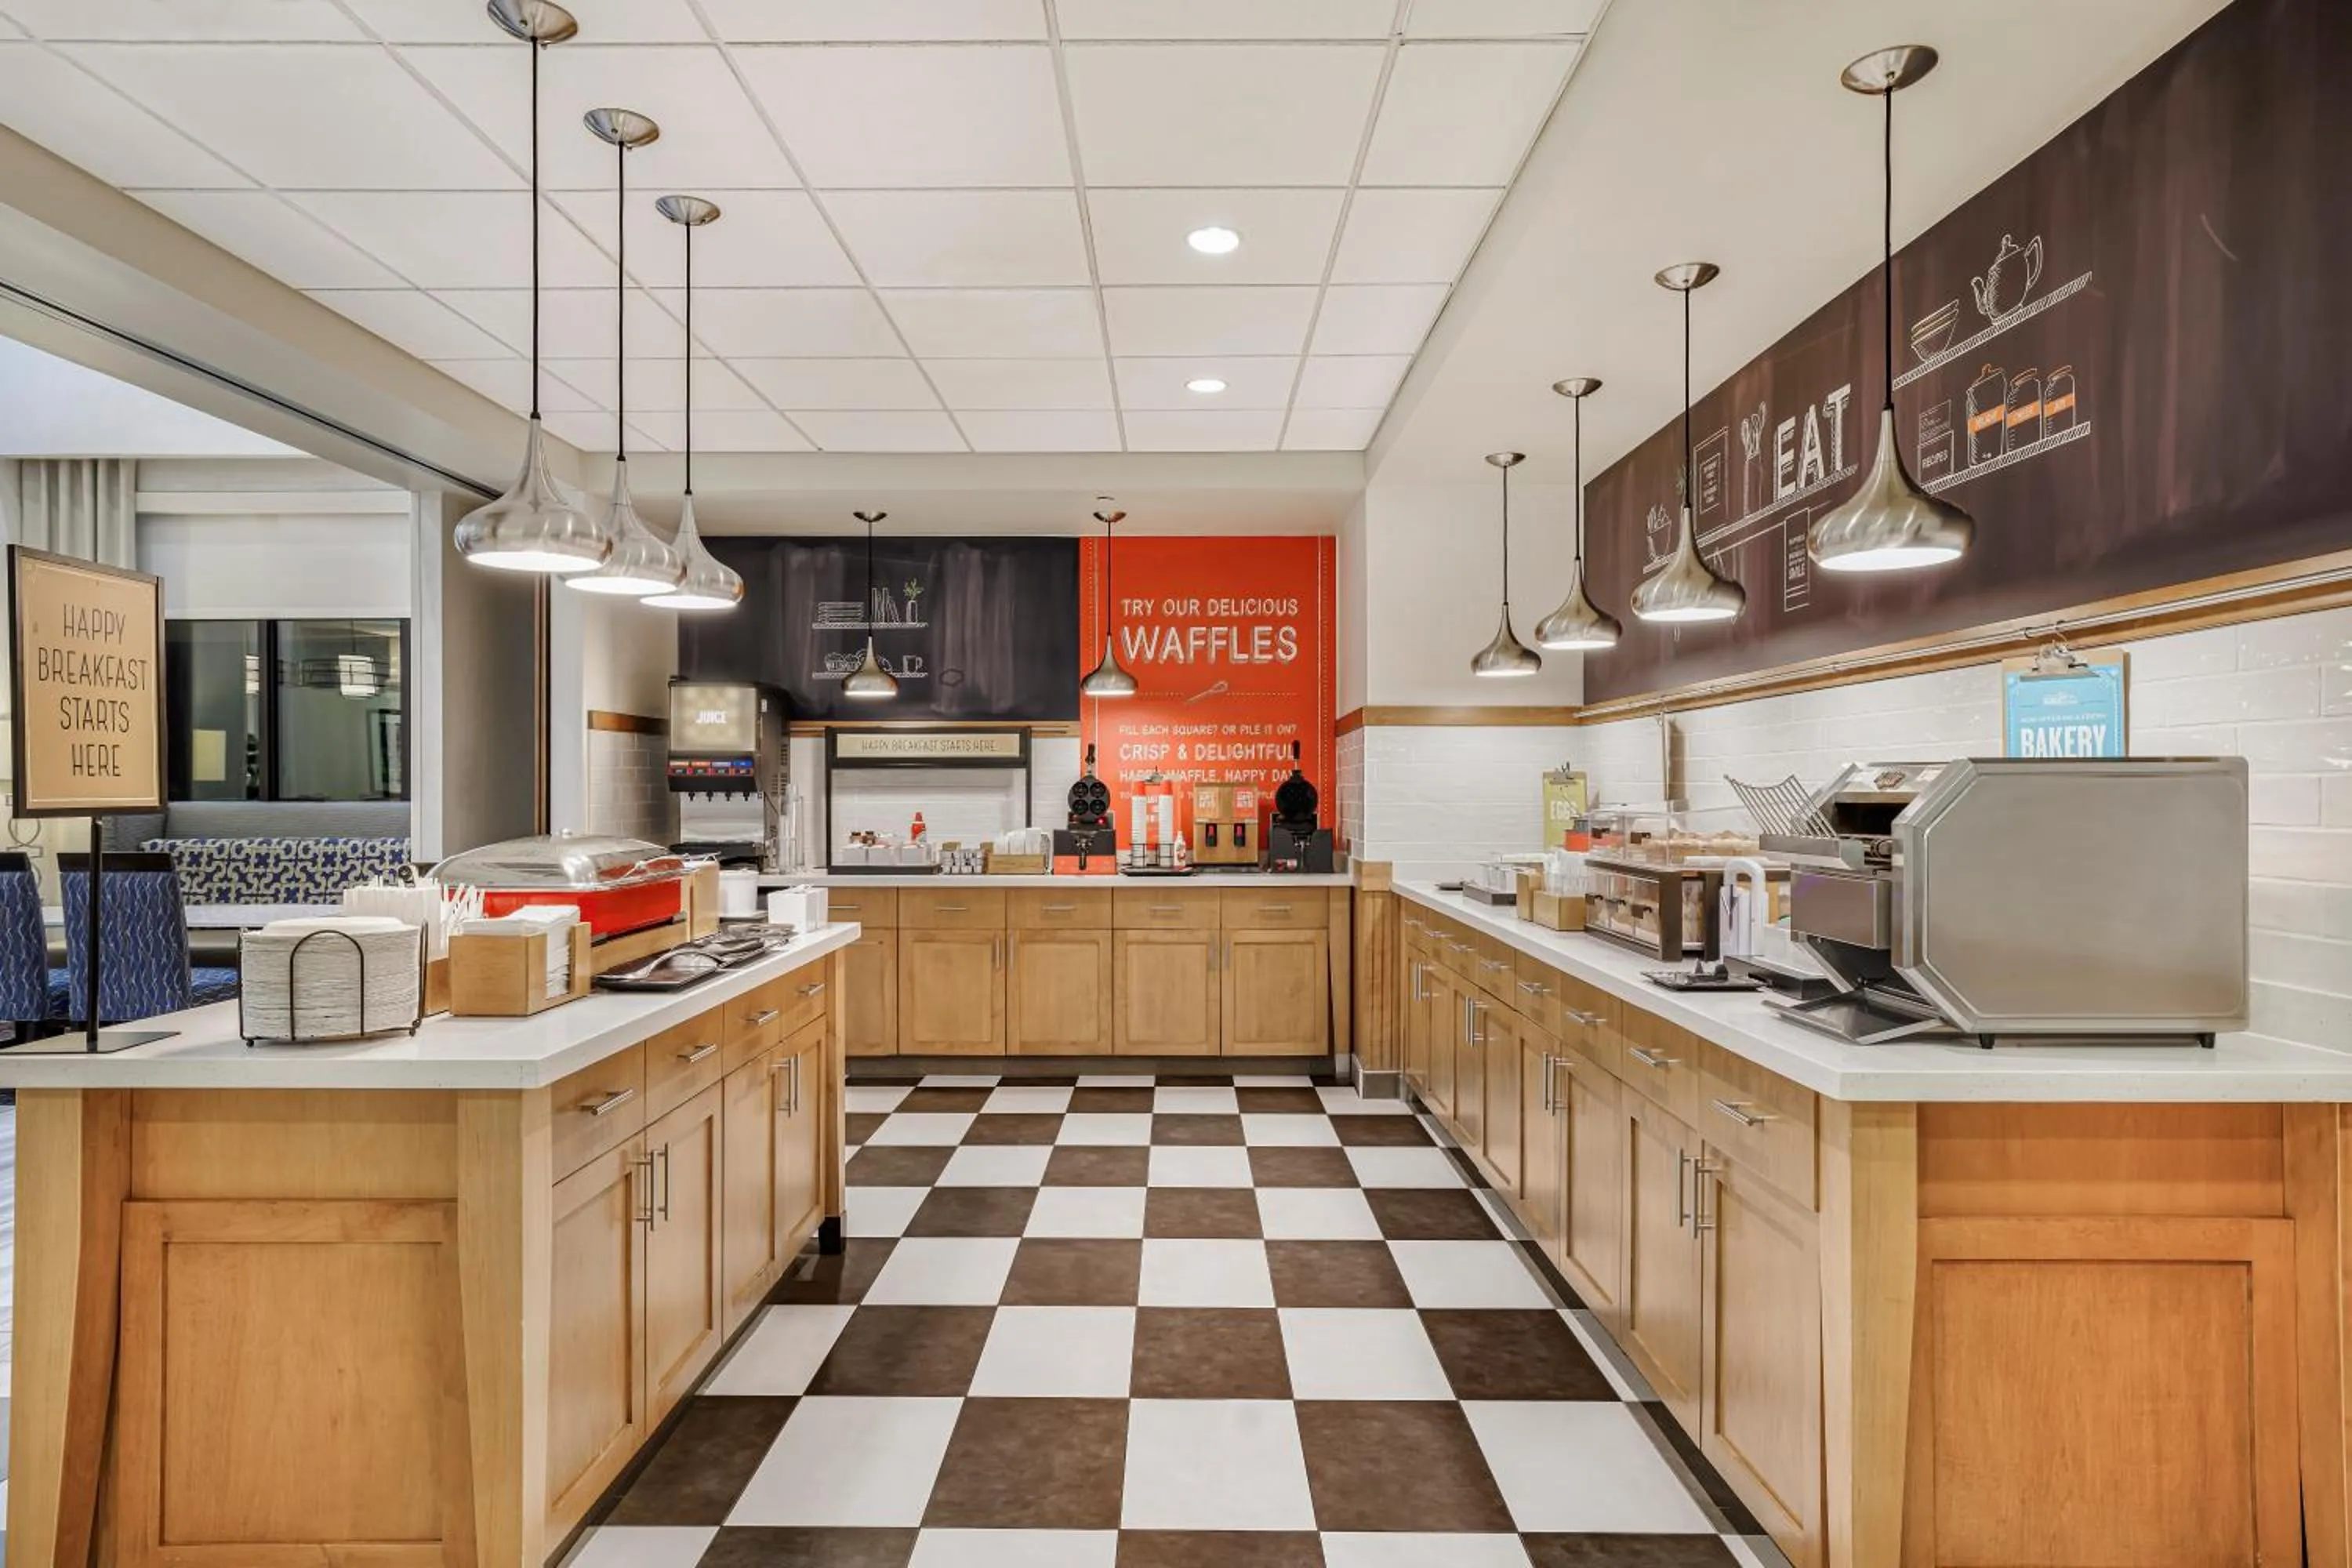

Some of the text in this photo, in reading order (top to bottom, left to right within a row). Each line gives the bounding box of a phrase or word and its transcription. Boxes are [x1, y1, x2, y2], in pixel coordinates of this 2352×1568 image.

[1773, 383, 1851, 501] EAT
[1922, 449, 1948, 469] RECIPES
[1121, 598, 1298, 616] TRY OUR DELICIOUS
[63, 603, 126, 644] HAPPY
[1121, 625, 1298, 665] WAFFLES
[38, 647, 147, 691] BREAKFAST
[60, 695, 129, 732] STARTS
[695, 710, 727, 724] JUICE
[1119, 724, 1297, 735] FILL EACH SQUARE? OR PILE IT ON?
[940, 739, 971, 752] STARTS
[2020, 724, 2107, 757] BAKERY
[71, 743, 122, 777] HERE
[1120, 743, 1294, 761] CRISP & DELIGHTFUL
[1225, 768, 1267, 782] HAPPY
[1551, 800, 1579, 820] EGGS
